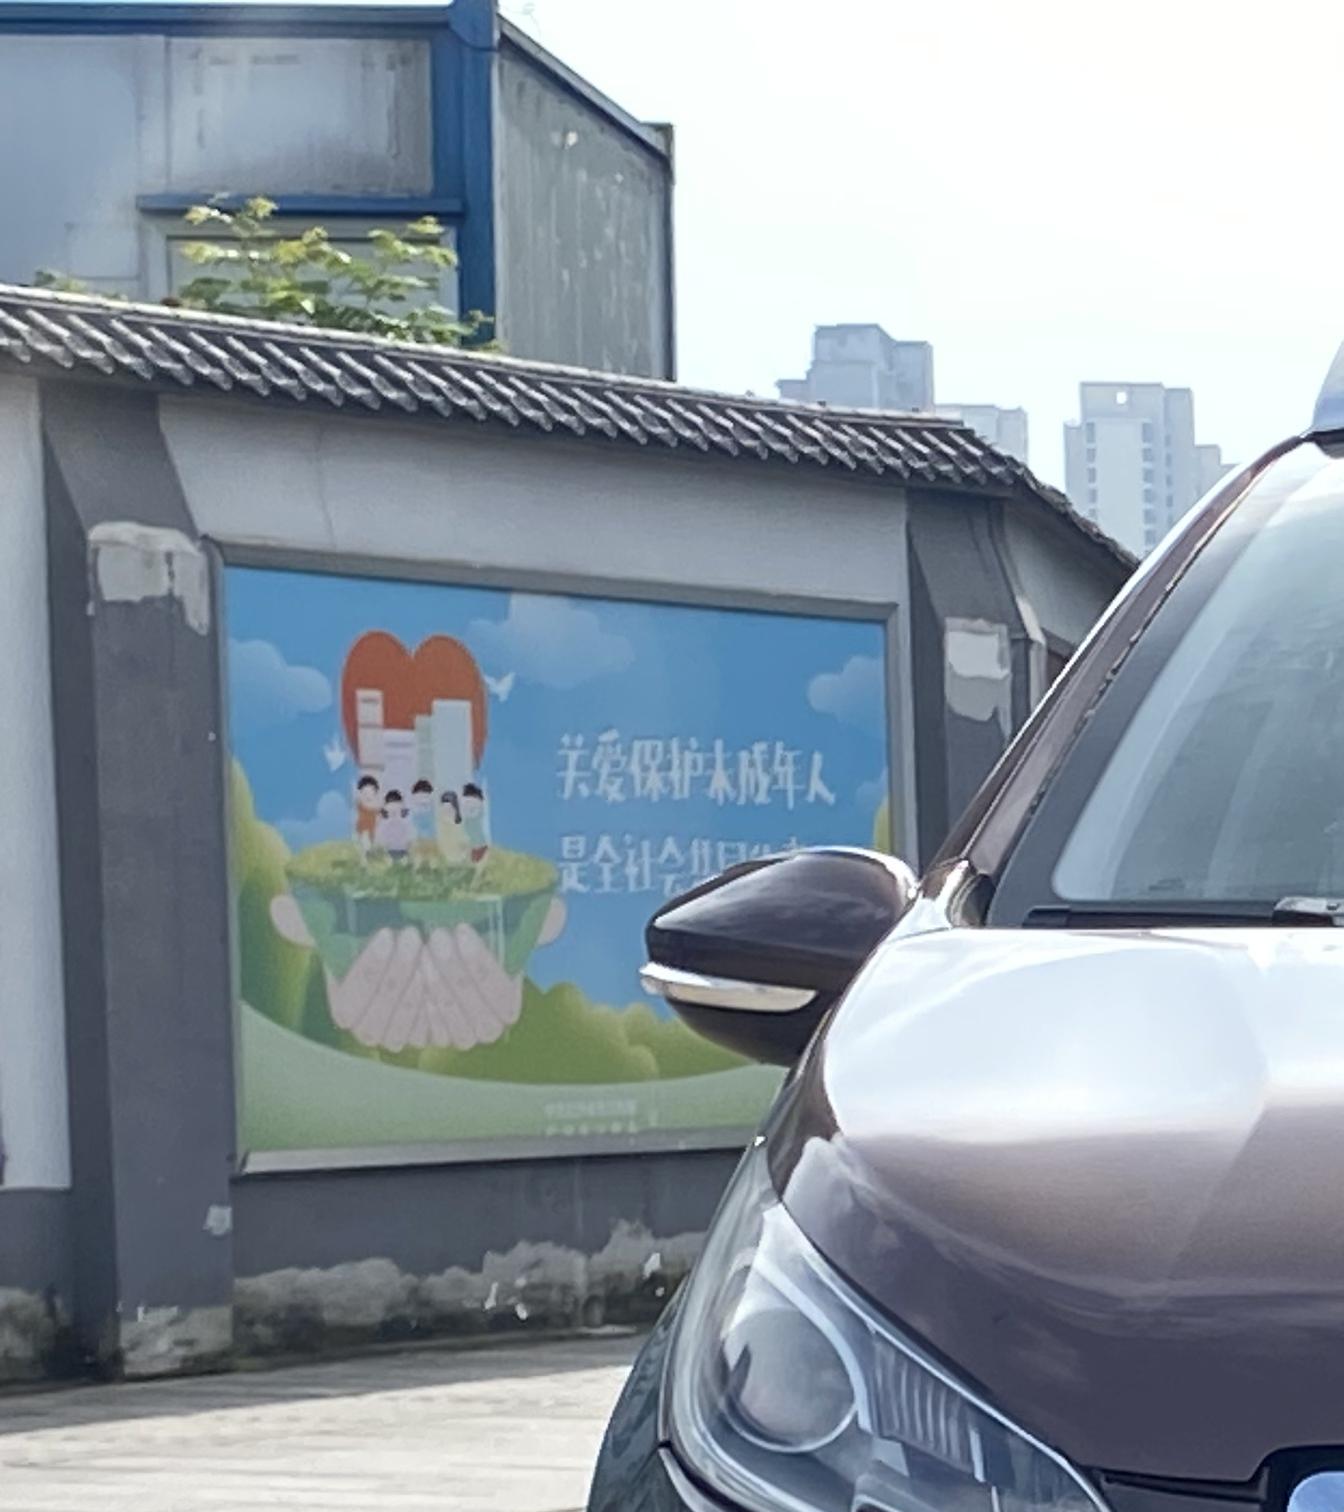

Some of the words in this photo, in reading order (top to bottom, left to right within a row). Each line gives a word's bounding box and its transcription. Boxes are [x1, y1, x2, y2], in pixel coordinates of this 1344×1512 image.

[557, 729, 836, 809] 关爱保护未成年人
[558, 833, 801, 897] 是全社会共同
